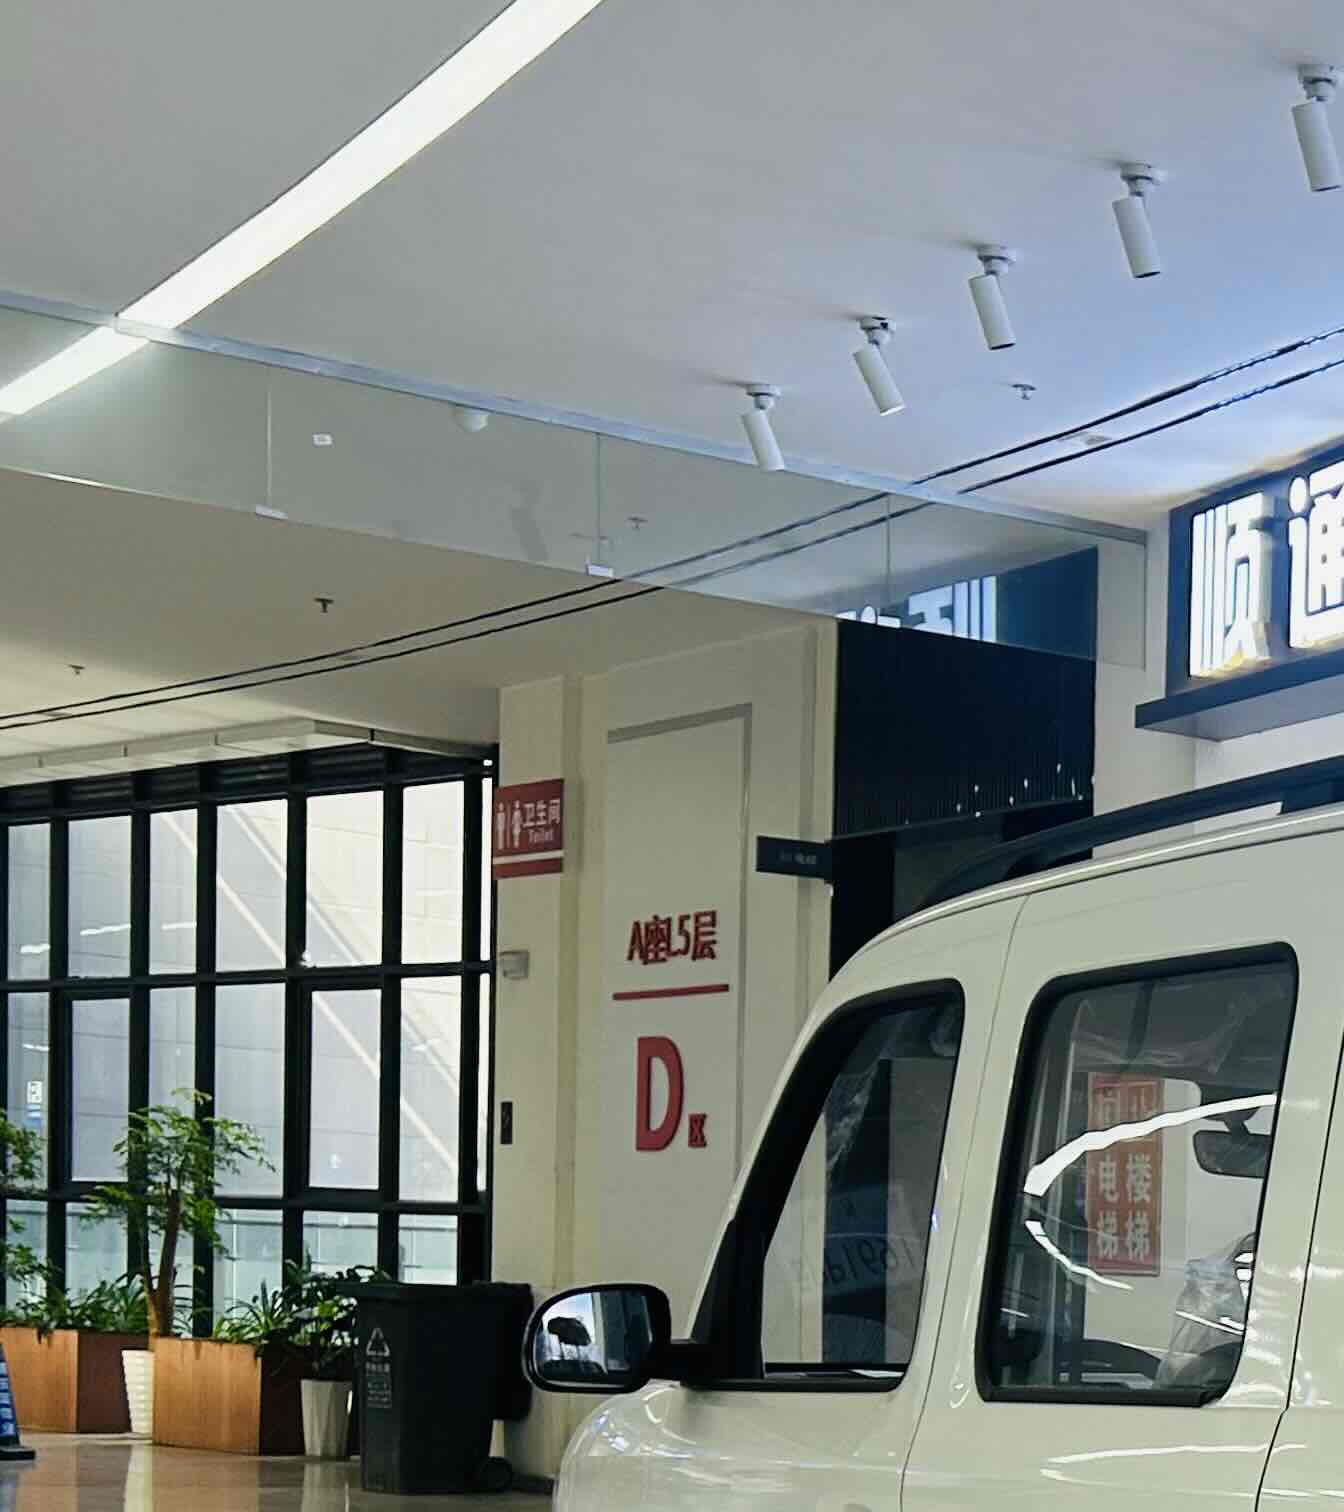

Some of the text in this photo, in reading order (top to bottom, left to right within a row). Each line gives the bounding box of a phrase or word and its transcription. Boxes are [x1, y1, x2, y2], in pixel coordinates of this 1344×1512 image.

[522, 797, 561, 828] 卫生间
[626, 909, 718, 966] A座L5层
[1098, 1153, 1120, 1261] 电梯
